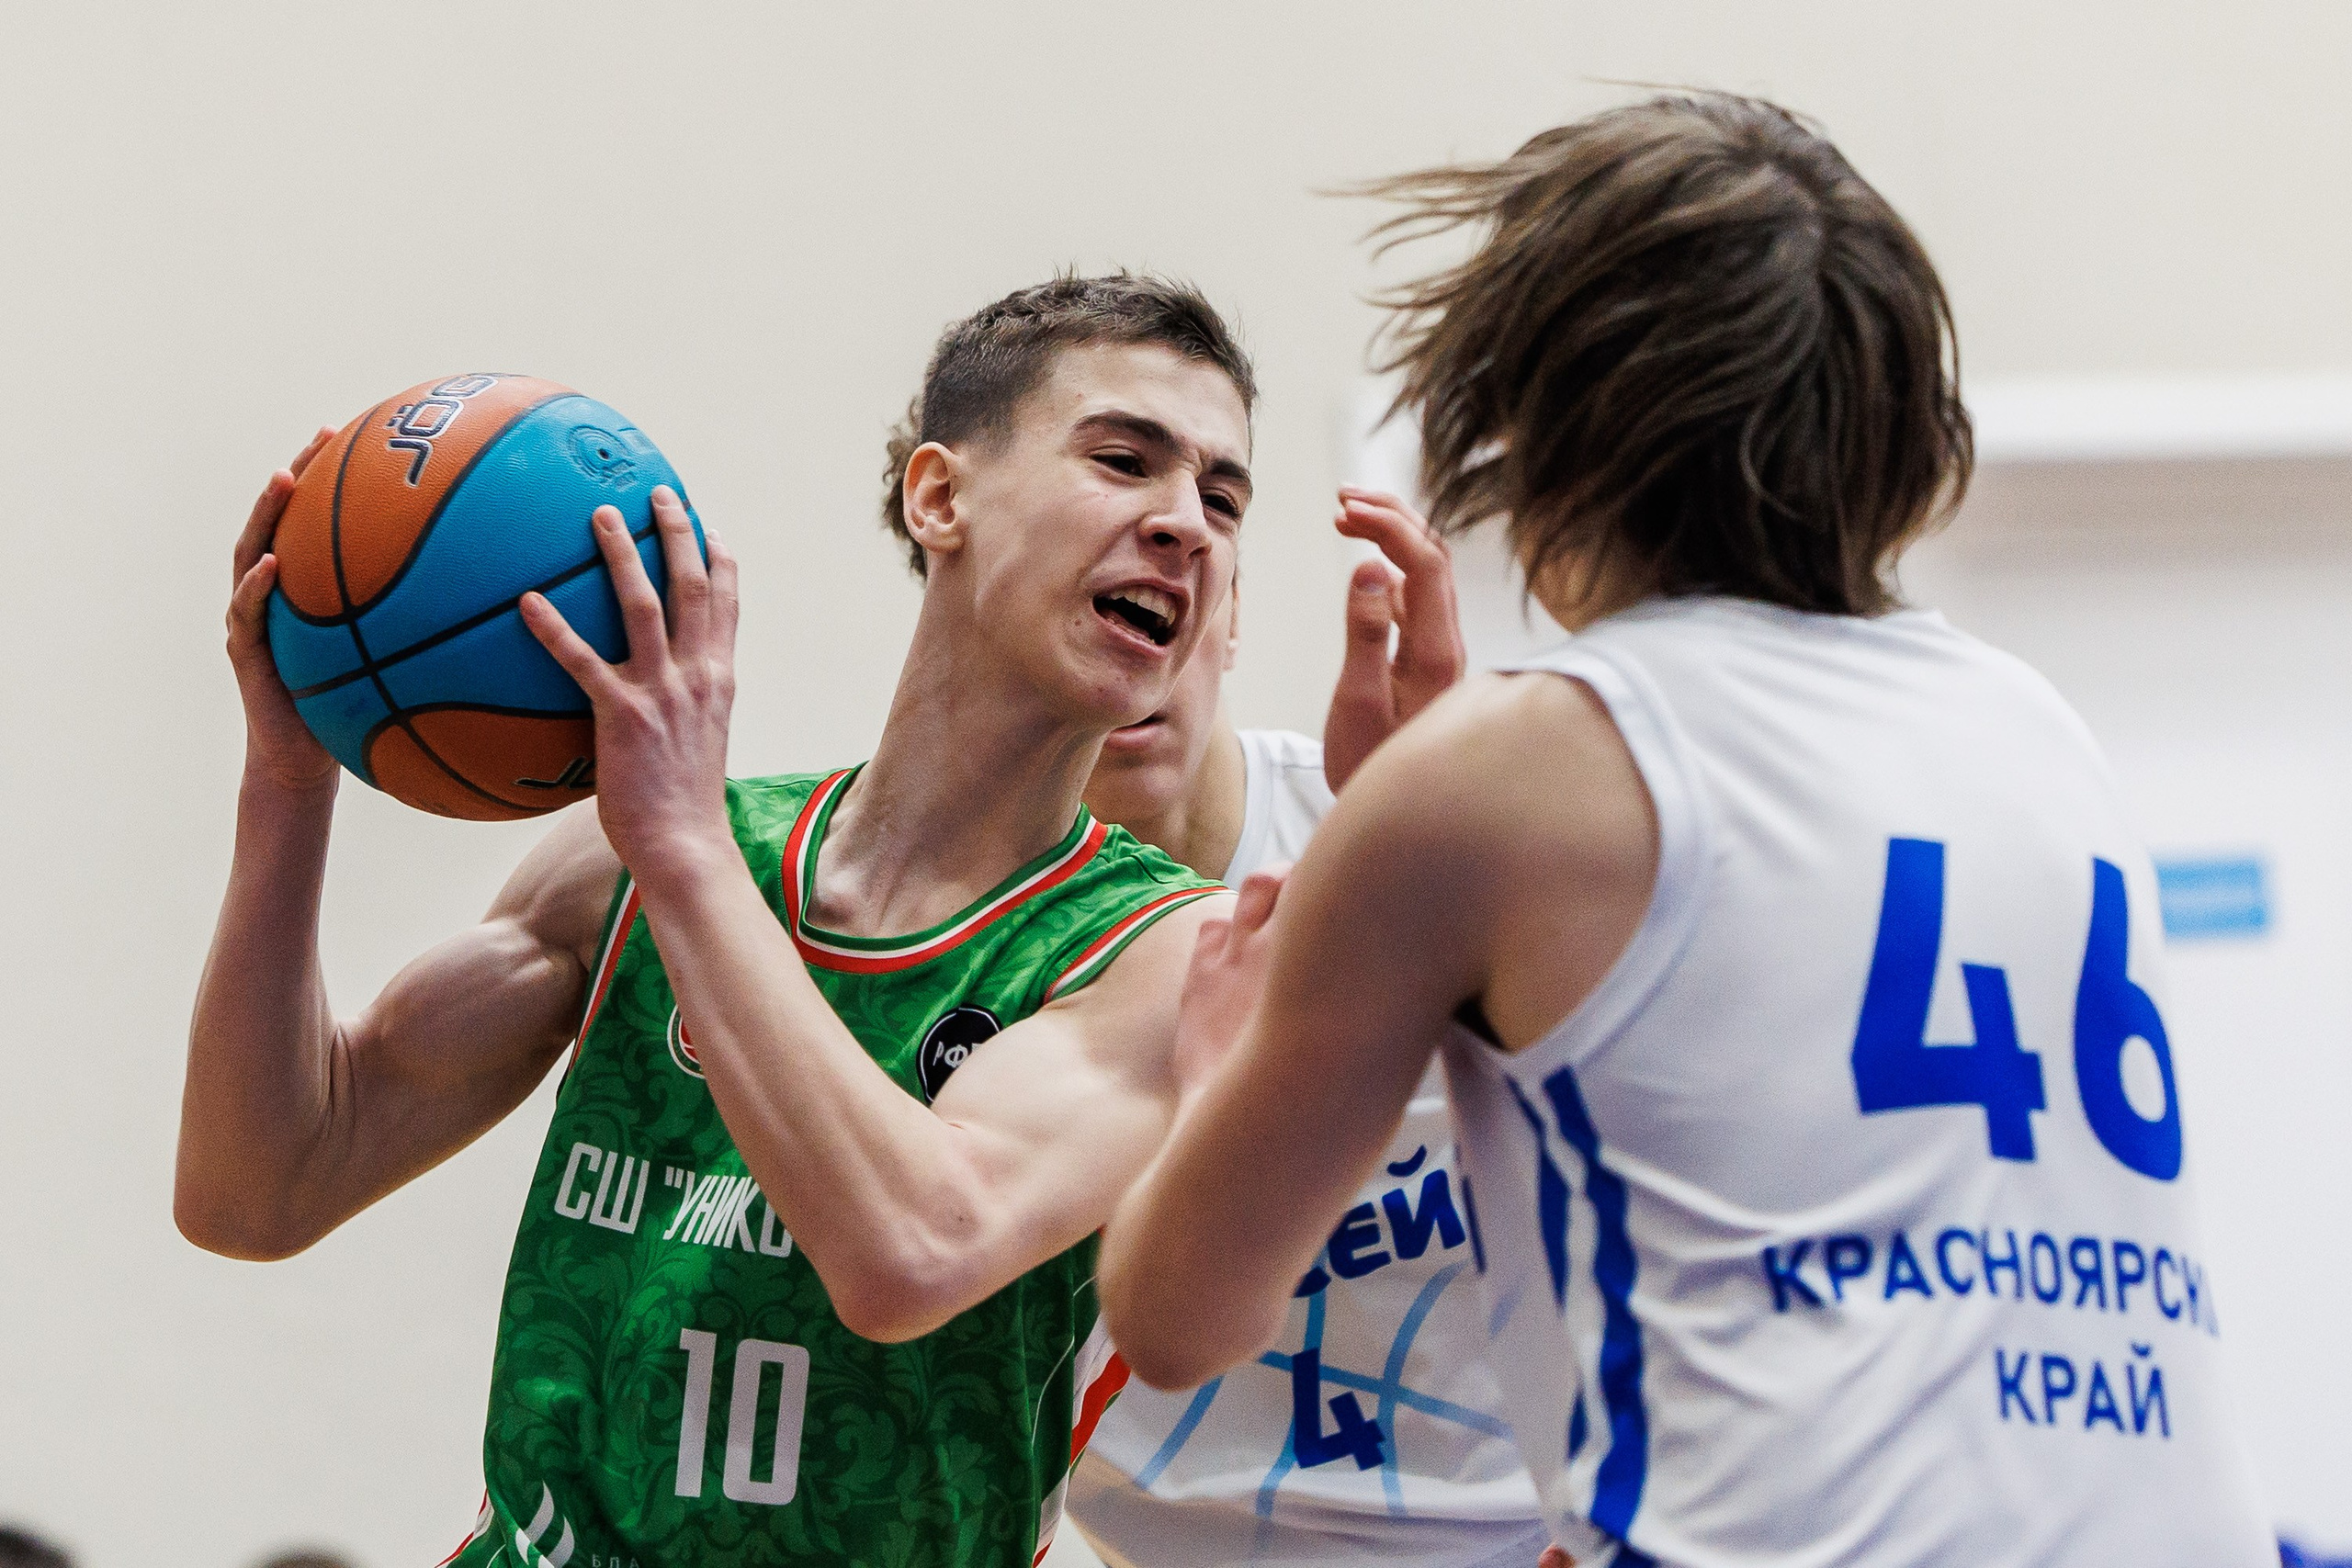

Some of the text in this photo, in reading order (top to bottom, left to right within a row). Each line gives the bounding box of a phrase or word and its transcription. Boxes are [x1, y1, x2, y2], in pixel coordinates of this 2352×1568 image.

[386, 373, 526, 488] JÖG
[1850, 836, 2183, 1182] 46
[554, 1142, 650, 1235] СШ
[1295, 1145, 1466, 1298] ЕЙ
[1764, 1227, 2220, 1338] КРАСНОЯРСК
[674, 1327, 810, 1506] 10
[1292, 1347, 1385, 1471] 4
[1995, 1342, 2171, 1440] КРАЙ
